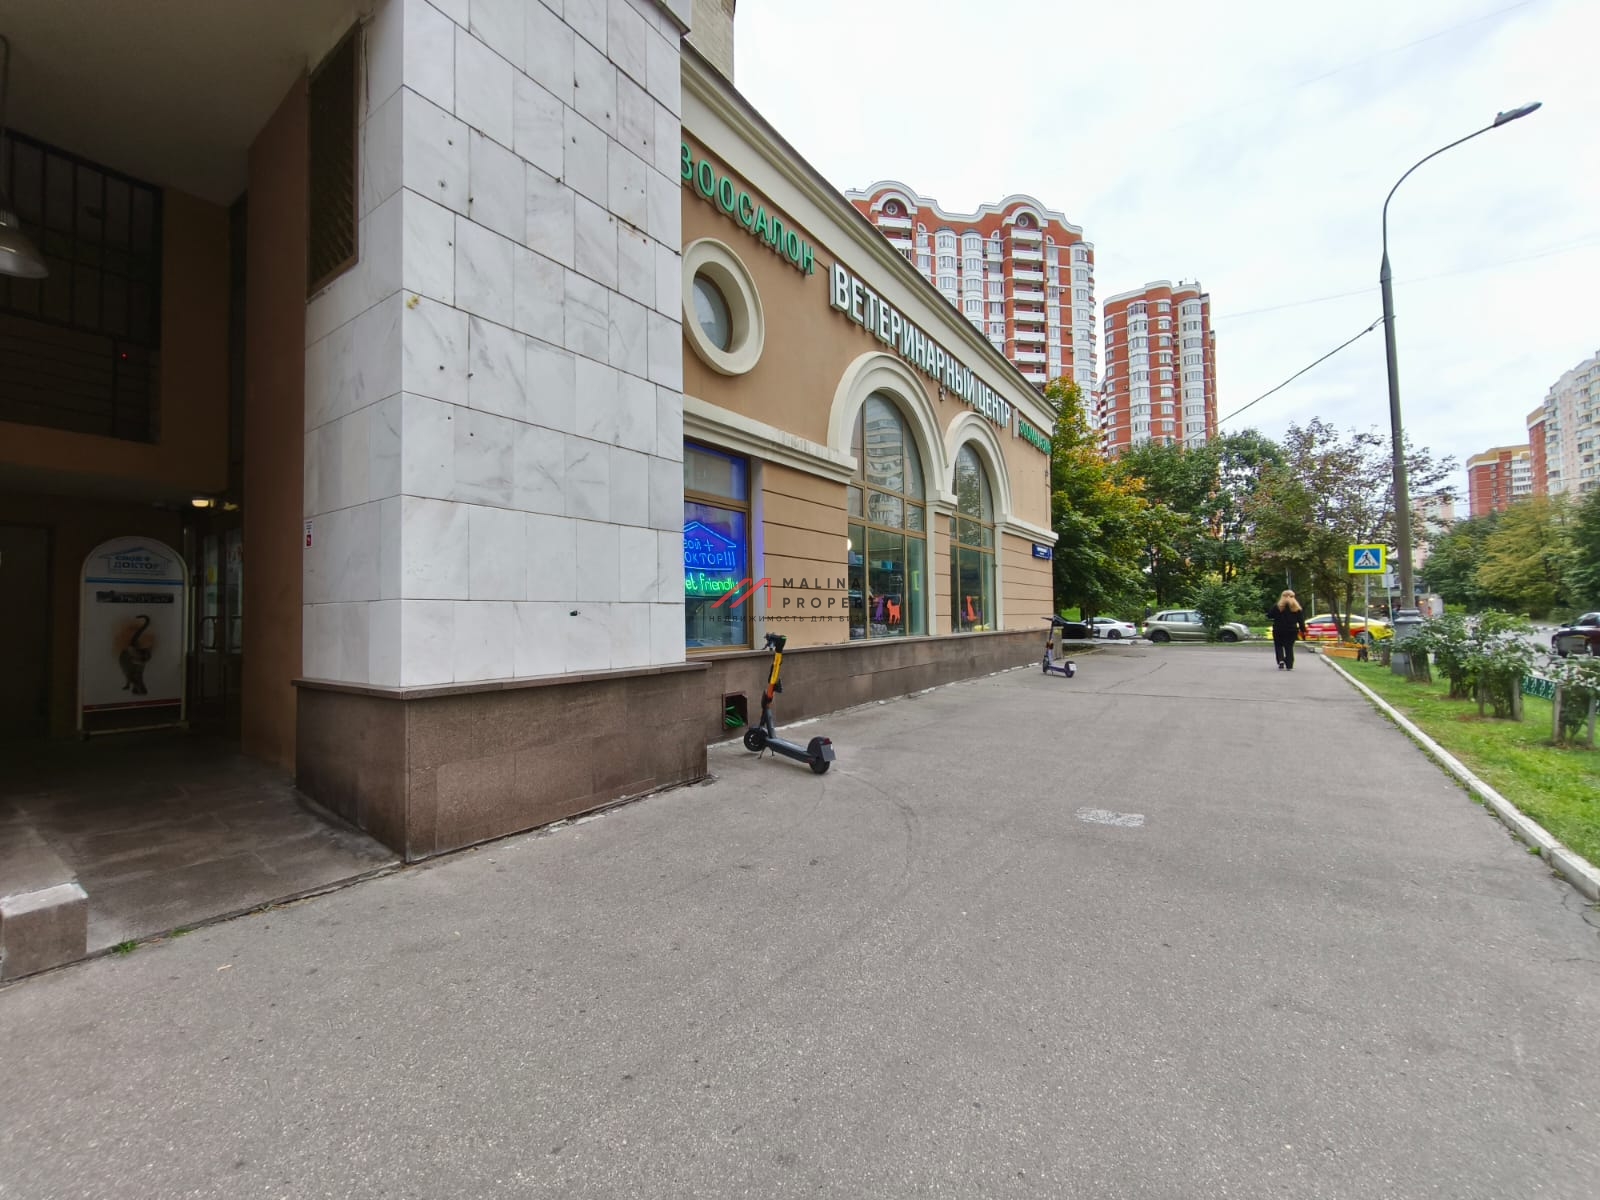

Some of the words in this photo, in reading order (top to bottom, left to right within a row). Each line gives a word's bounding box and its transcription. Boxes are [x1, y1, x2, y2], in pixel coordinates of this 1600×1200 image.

[681, 142, 815, 276] ЗООСАЛОН
[830, 262, 976, 402] ВЕТЕРИНАРНЫЙ
[977, 380, 1011, 428] ЦЕНТР
[685, 572, 698, 590] et
